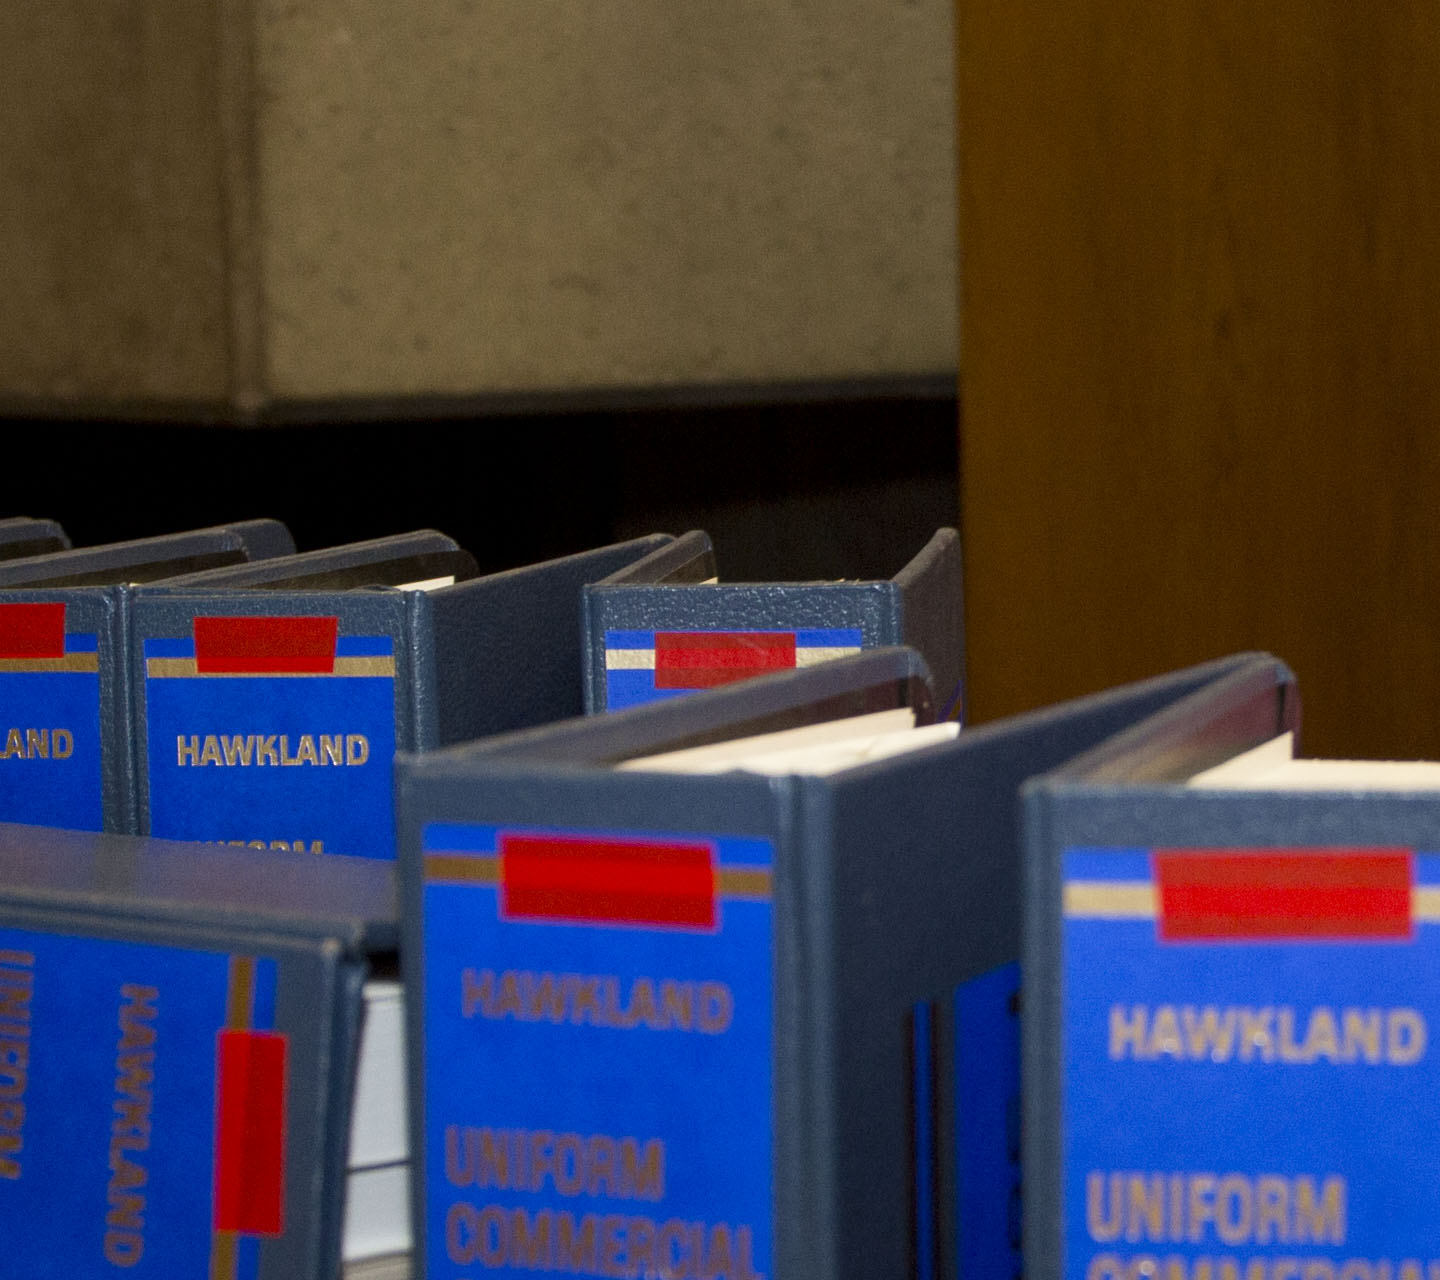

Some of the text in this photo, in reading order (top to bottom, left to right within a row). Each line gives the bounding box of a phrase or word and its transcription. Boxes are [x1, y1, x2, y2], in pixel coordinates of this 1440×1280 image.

[176, 733, 370, 767] HAWKLAND
[462, 968, 733, 1034] HAWKLAND
[1108, 1004, 1426, 1065] HAWKLAND
[104, 983, 159, 1268] HAWKLAND
[444, 1125, 666, 1202] UNIFORM
[1086, 1170, 1346, 1246] UNIFORM
